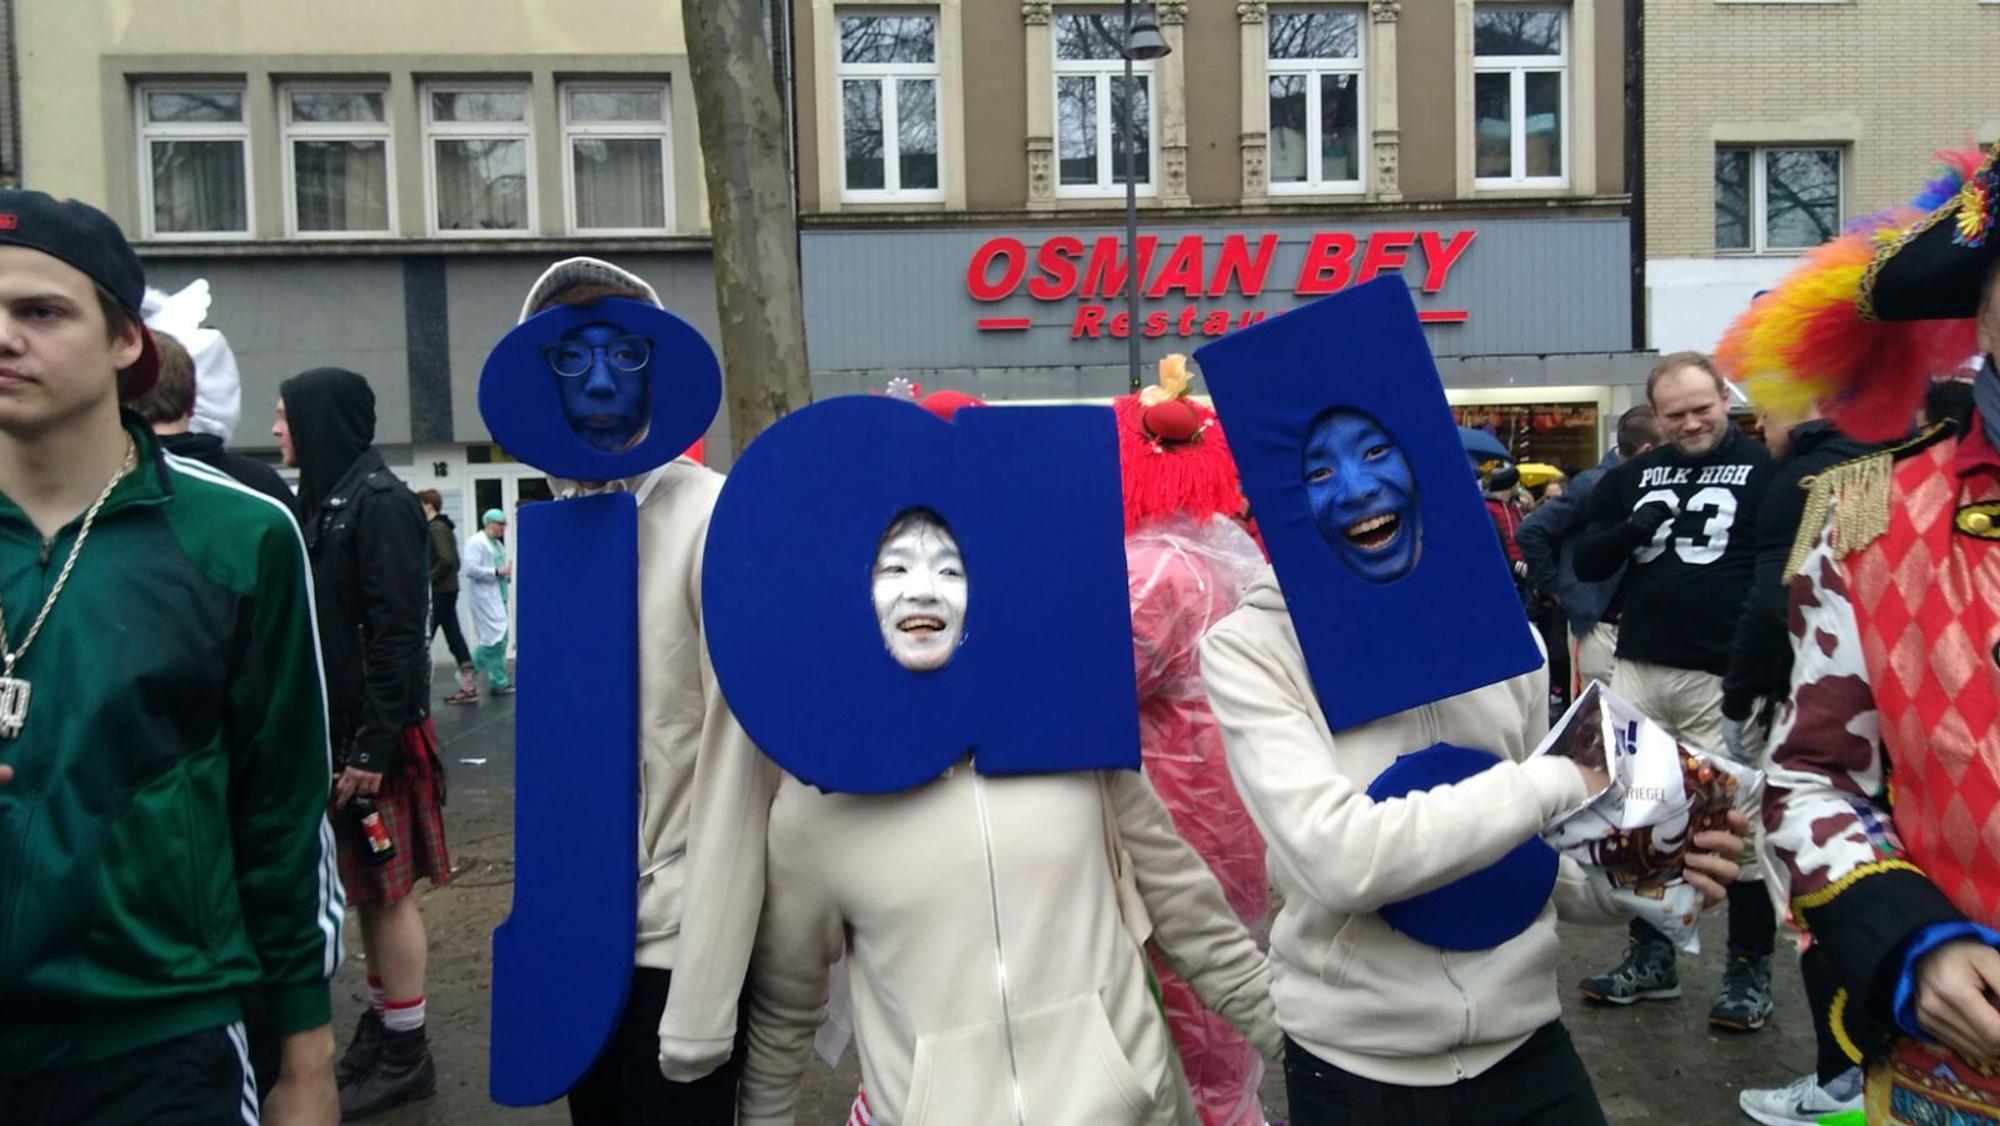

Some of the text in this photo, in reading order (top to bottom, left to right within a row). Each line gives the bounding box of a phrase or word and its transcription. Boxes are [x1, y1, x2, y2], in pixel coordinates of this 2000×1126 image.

[966, 230, 1477, 301] OSMAN BEY
[1638, 465, 1753, 488] POLK HIGH
